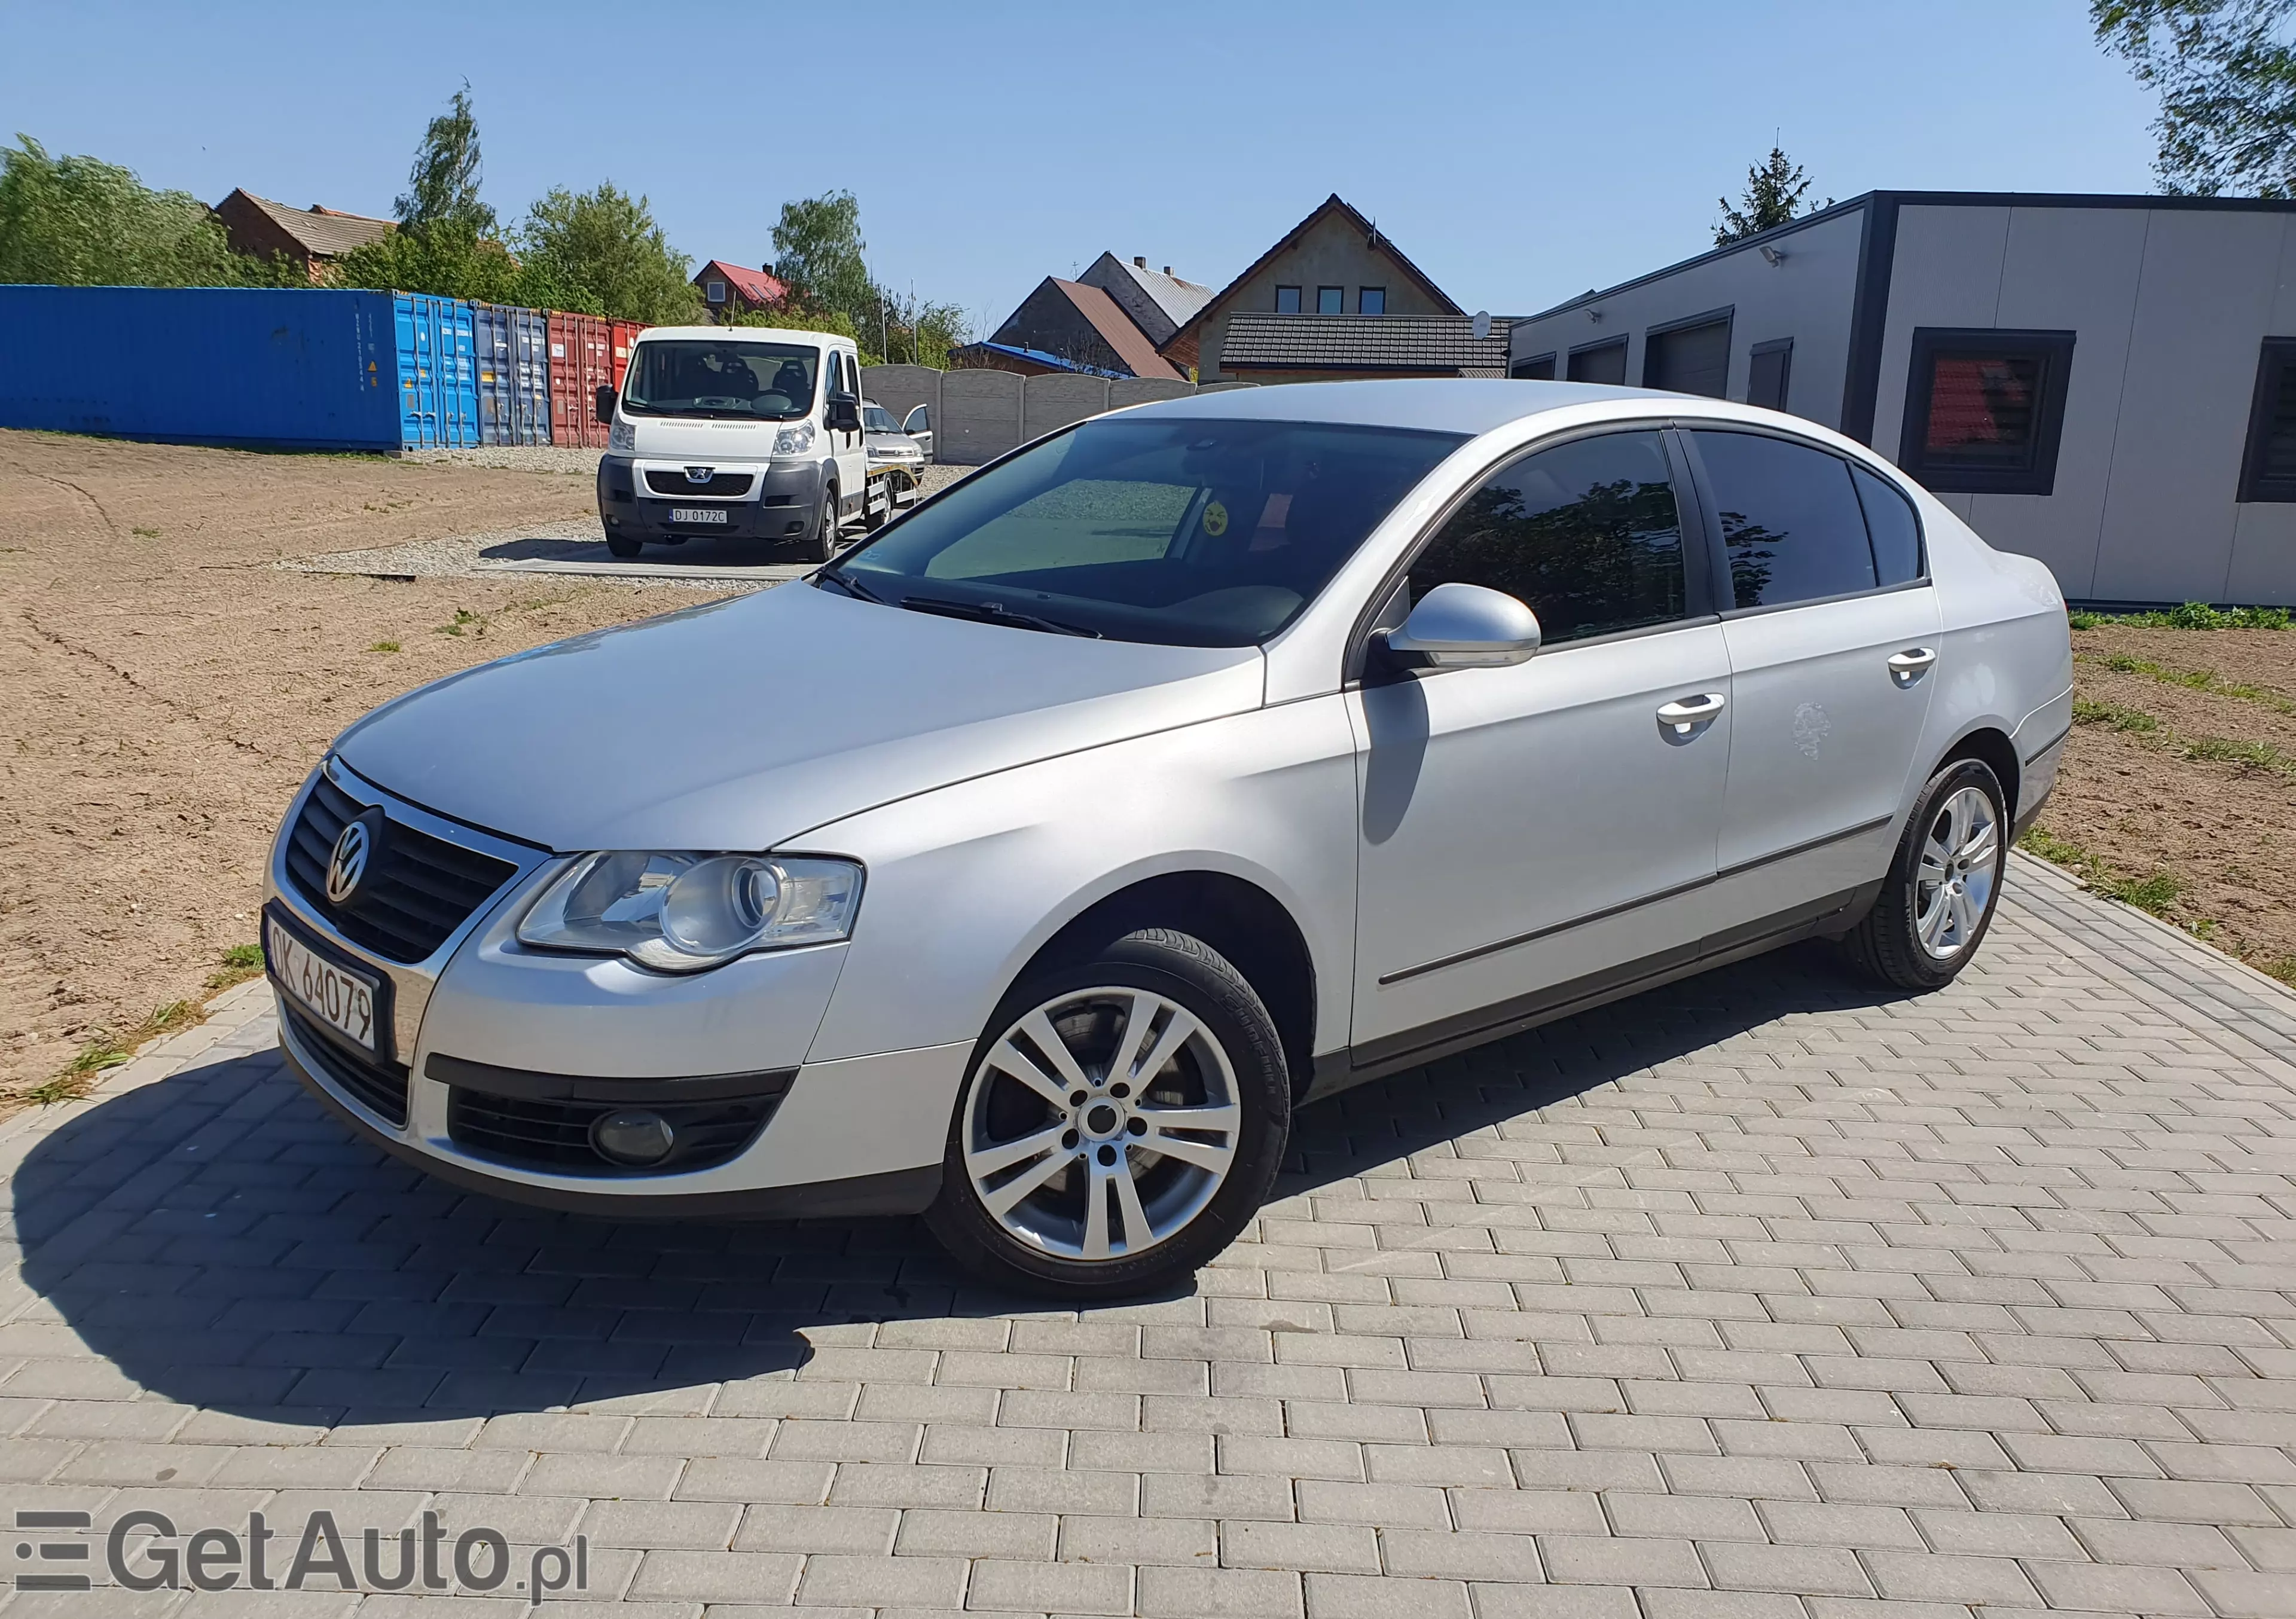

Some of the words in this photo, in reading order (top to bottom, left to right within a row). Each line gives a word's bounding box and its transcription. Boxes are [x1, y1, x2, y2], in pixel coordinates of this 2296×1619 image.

[675, 511, 688, 520] DJ
[692, 511, 724, 521] 0172C
[273, 927, 296, 991] OK
[303, 954, 371, 1040] 64079
